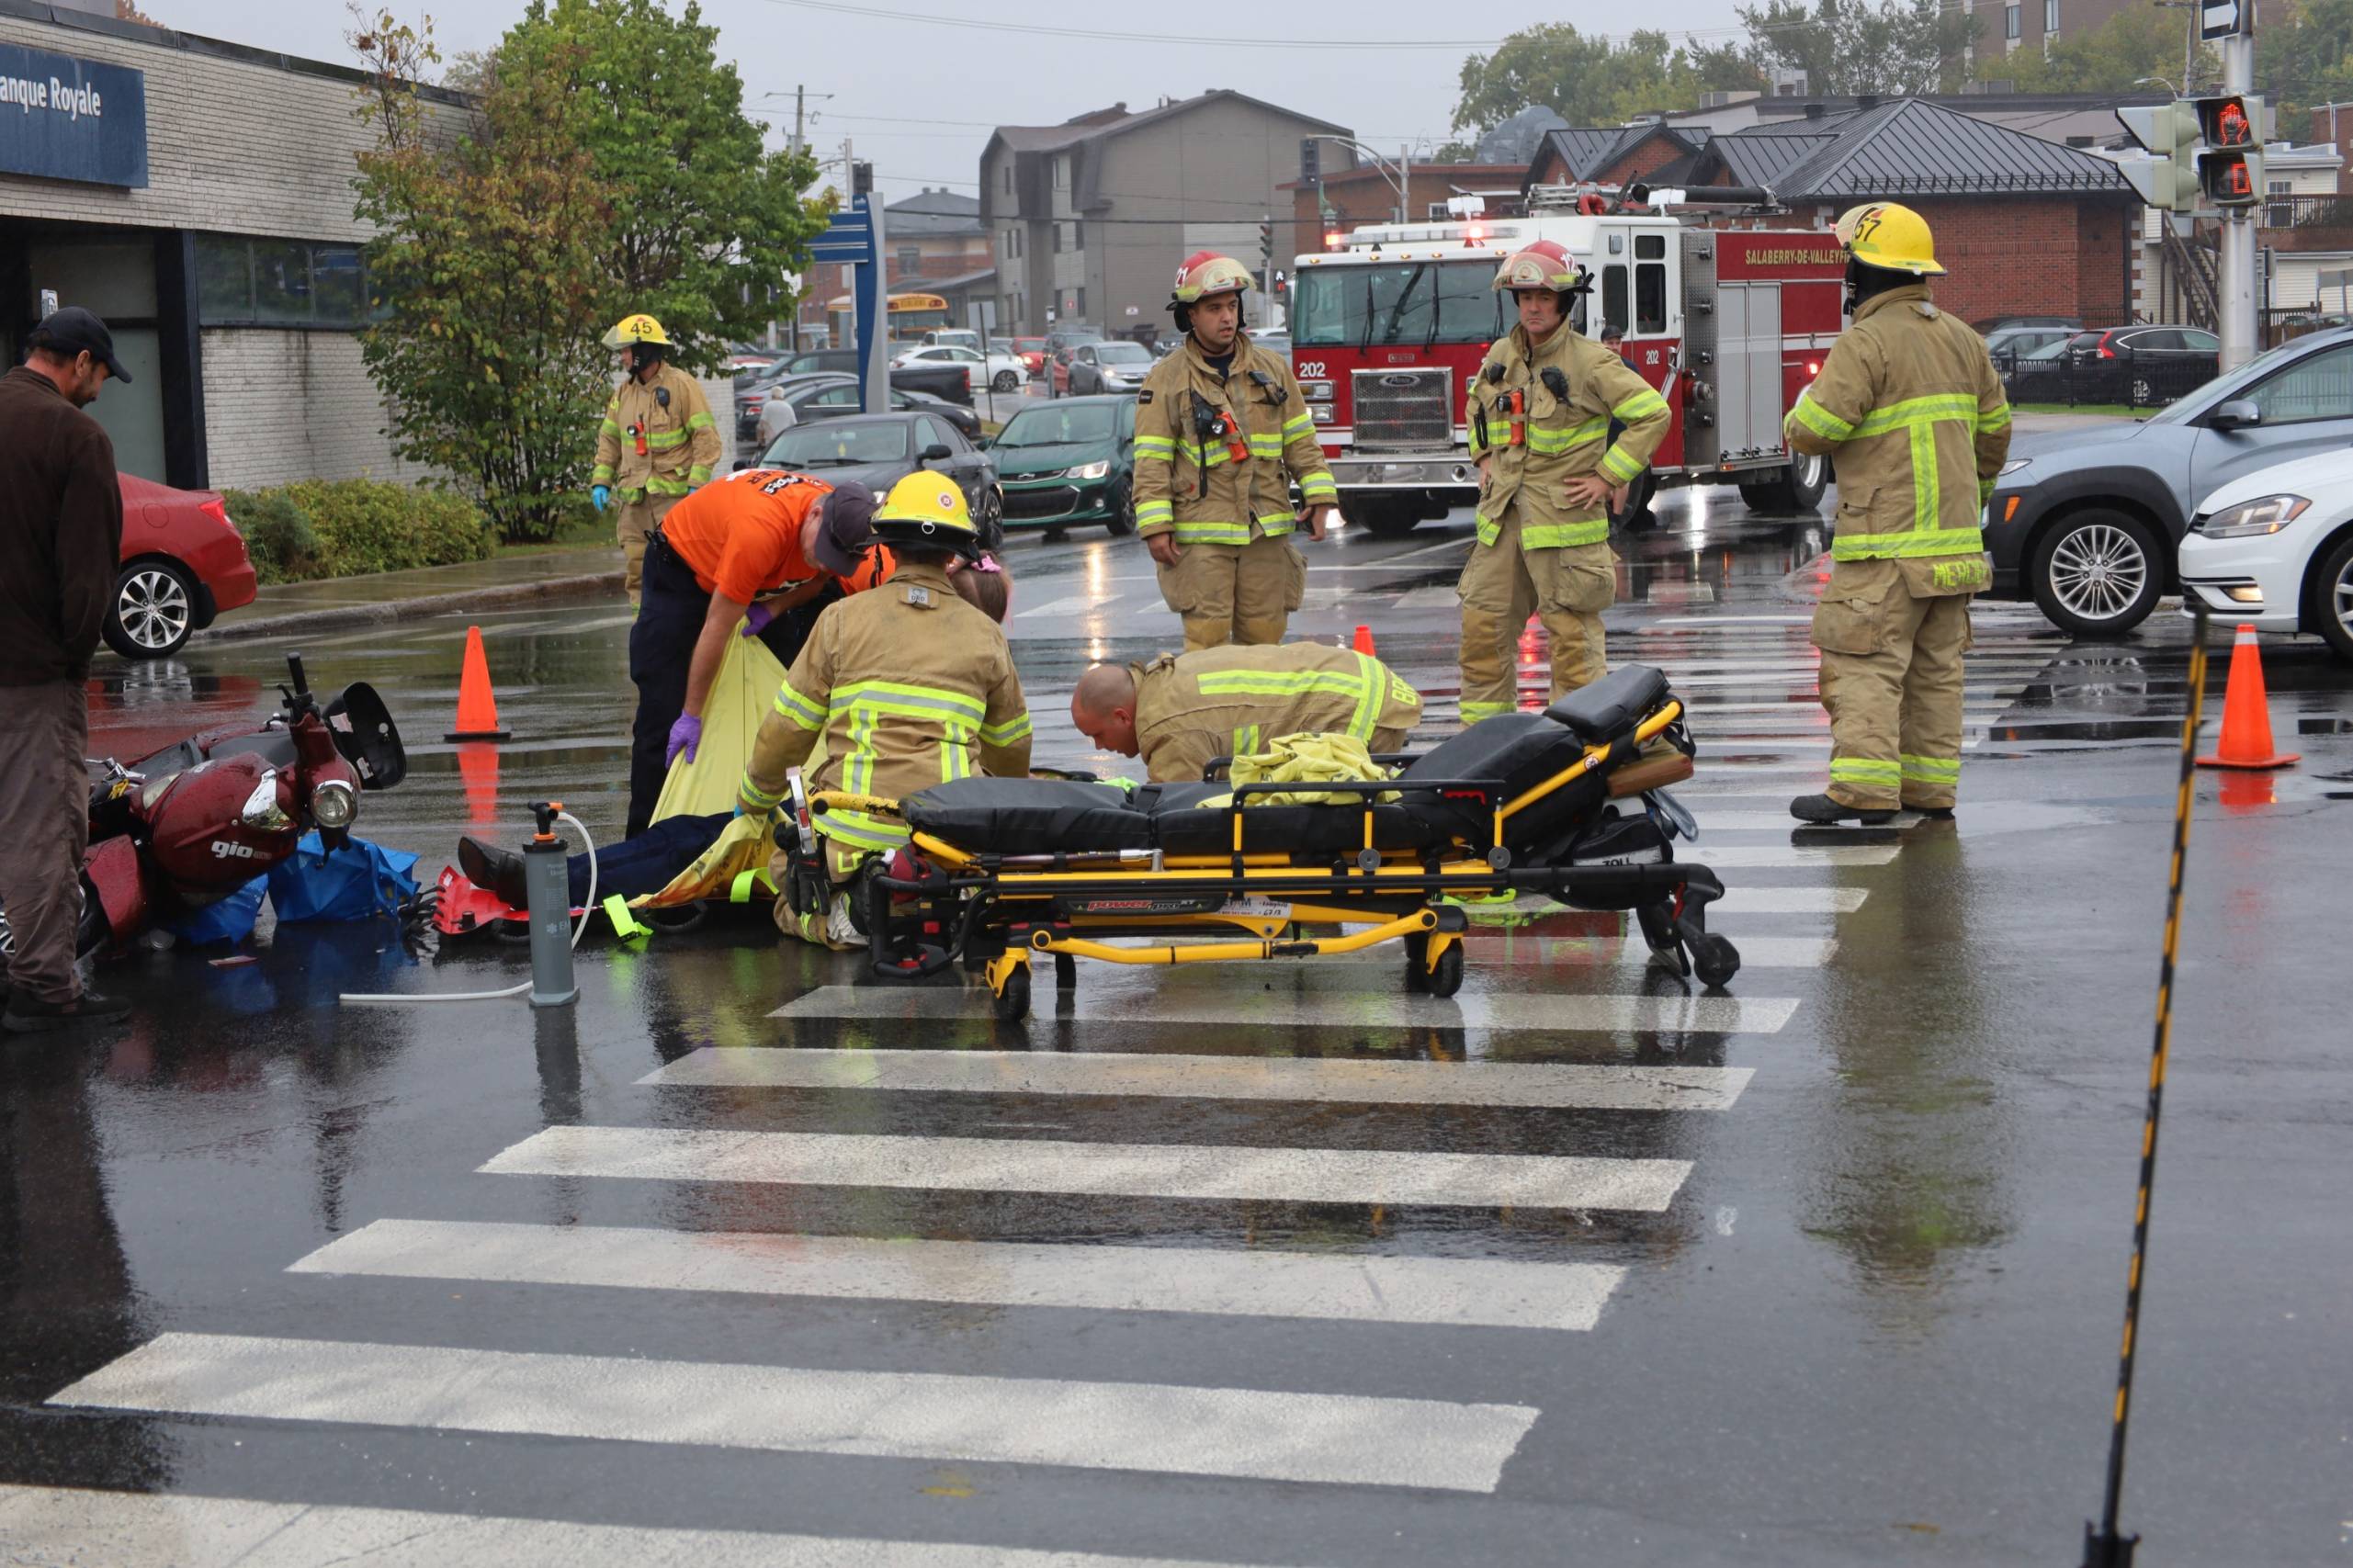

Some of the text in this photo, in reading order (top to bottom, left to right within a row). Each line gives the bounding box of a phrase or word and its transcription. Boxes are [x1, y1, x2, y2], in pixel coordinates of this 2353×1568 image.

[50, 76, 101, 121] Royale
[630, 321, 652, 334] 45
[1646, 349, 1660, 365] 202
[1299, 362, 1326, 378] 202
[211, 840, 254, 859] gio
